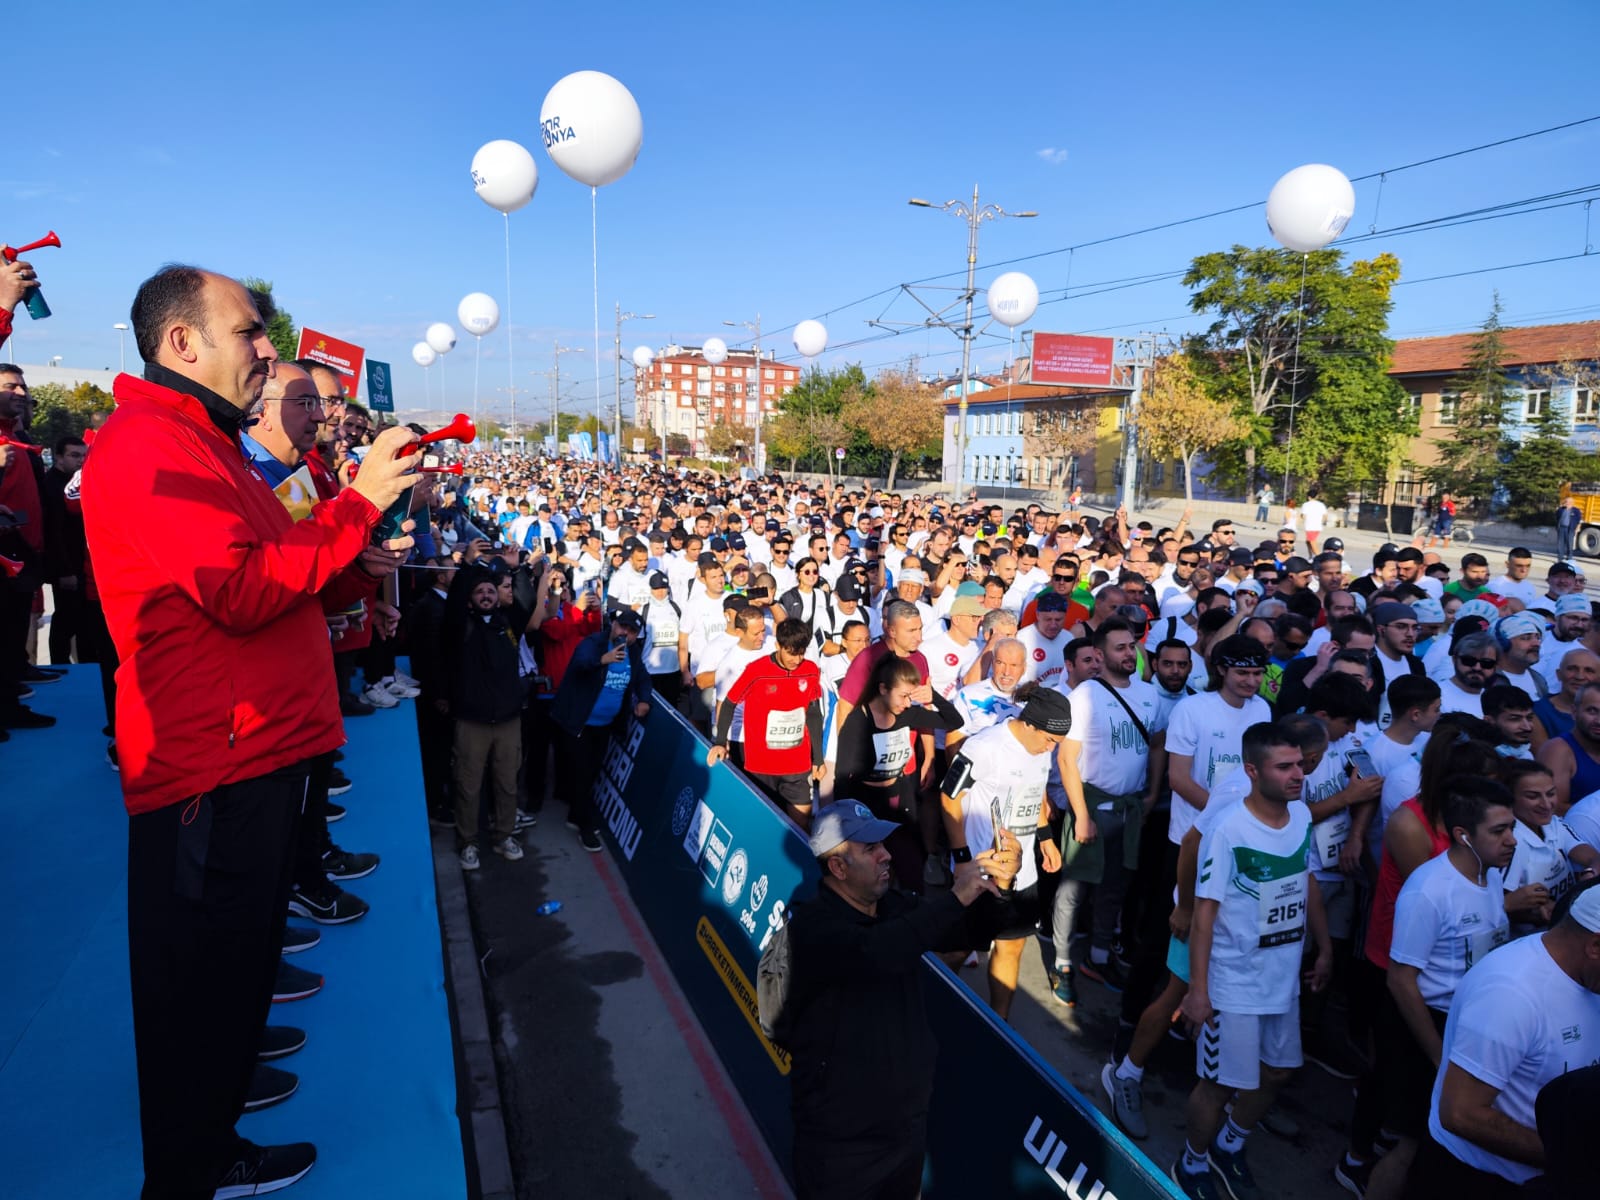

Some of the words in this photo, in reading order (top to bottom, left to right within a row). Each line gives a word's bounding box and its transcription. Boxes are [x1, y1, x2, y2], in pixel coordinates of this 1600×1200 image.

[543, 126, 576, 148] ONYA
[879, 748, 910, 764] 2075
[1267, 899, 1305, 924] 2164
